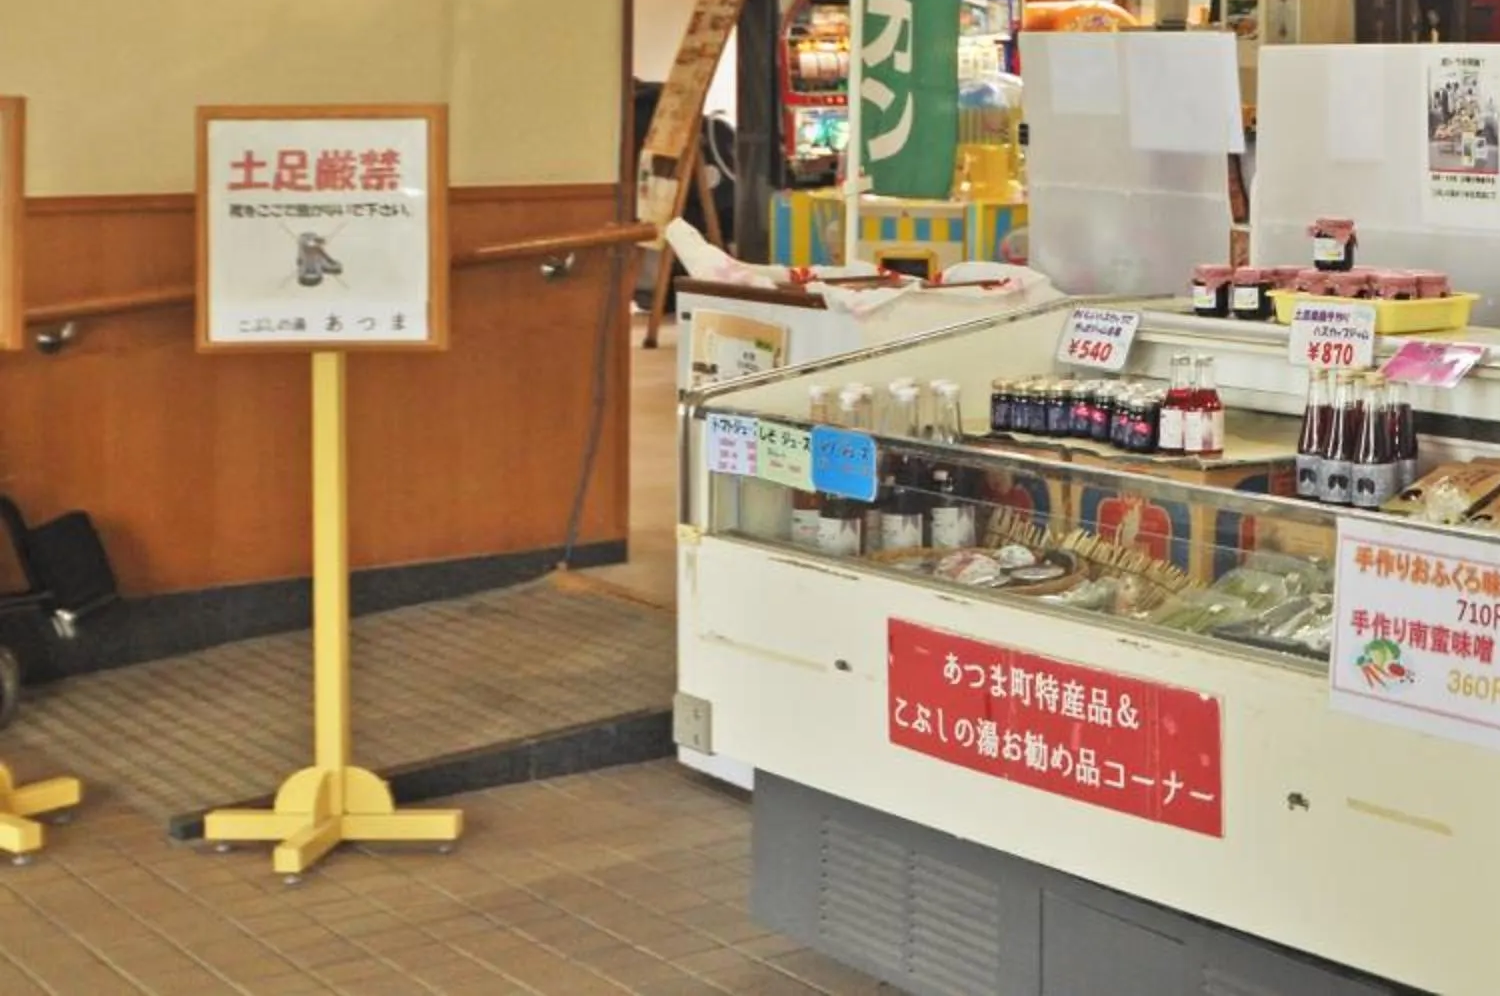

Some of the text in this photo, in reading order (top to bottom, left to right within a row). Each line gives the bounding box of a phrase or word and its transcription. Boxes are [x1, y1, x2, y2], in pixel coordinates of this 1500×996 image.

[227, 149, 402, 192] 土足厳禁
[325, 311, 406, 333] あつま
[1068, 338, 1113, 362] ¥540
[1307, 341, 1354, 366] ¥870
[1350, 608, 1496, 664] 手作り南蛮味噌
[943, 652, 1140, 730] あつま町特産品&
[893, 696, 1215, 806] こぶしの湯お勧め品コーナー
